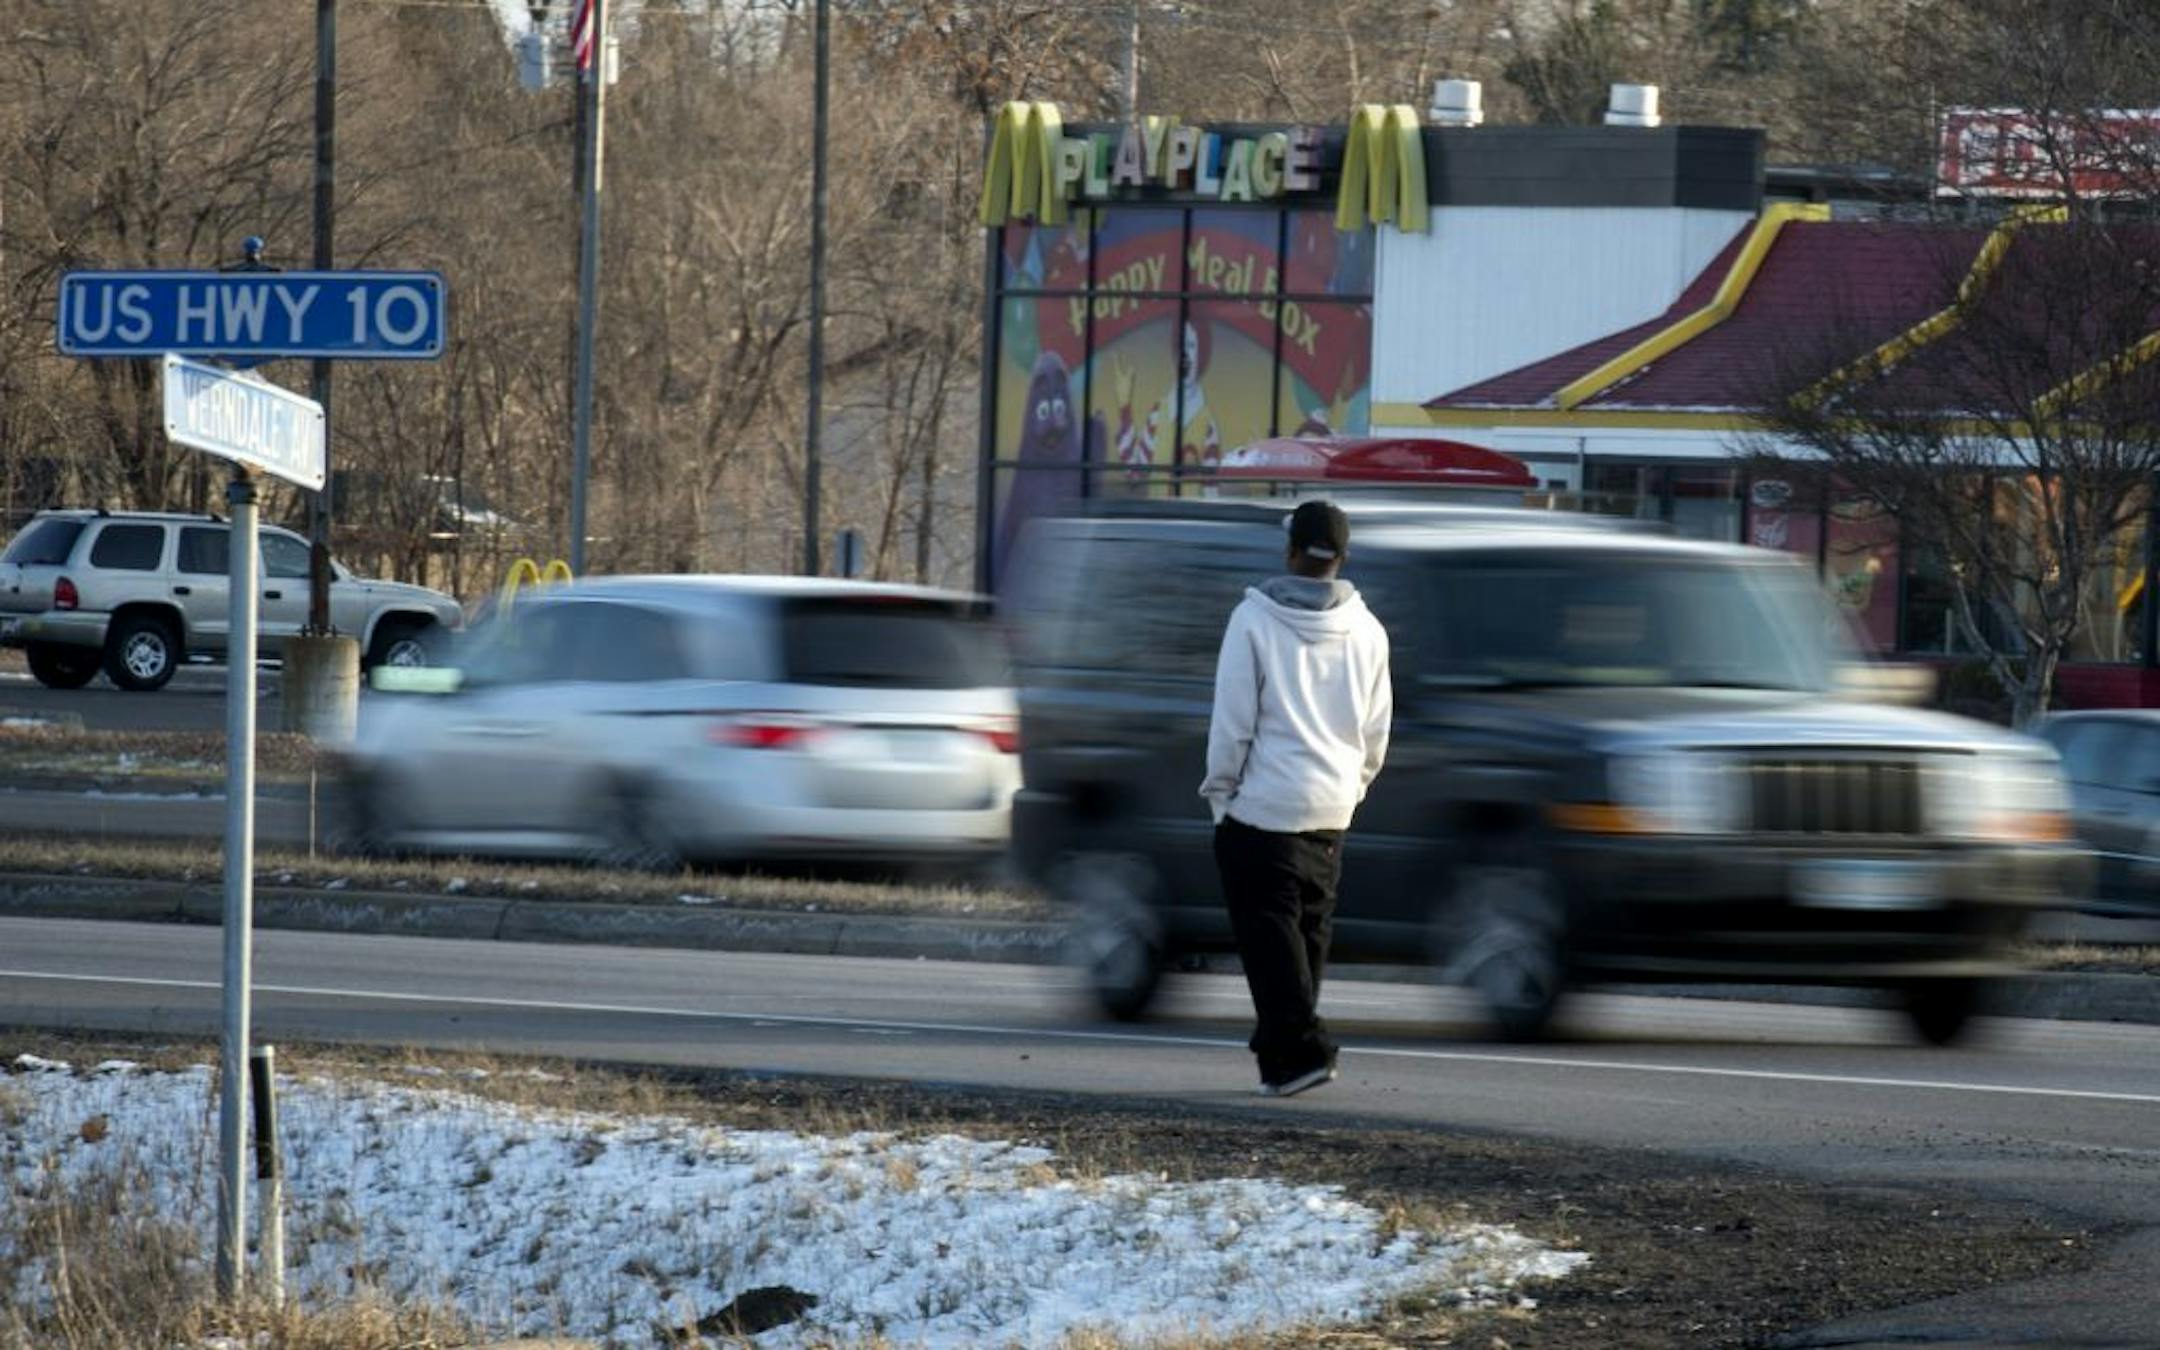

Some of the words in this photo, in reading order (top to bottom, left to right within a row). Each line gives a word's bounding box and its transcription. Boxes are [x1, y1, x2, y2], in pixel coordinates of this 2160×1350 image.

[1055, 115, 1321, 202] PLAYPLACE
[72, 284, 153, 343] US
[175, 285, 321, 343] HWY
[347, 285, 430, 345] 10
